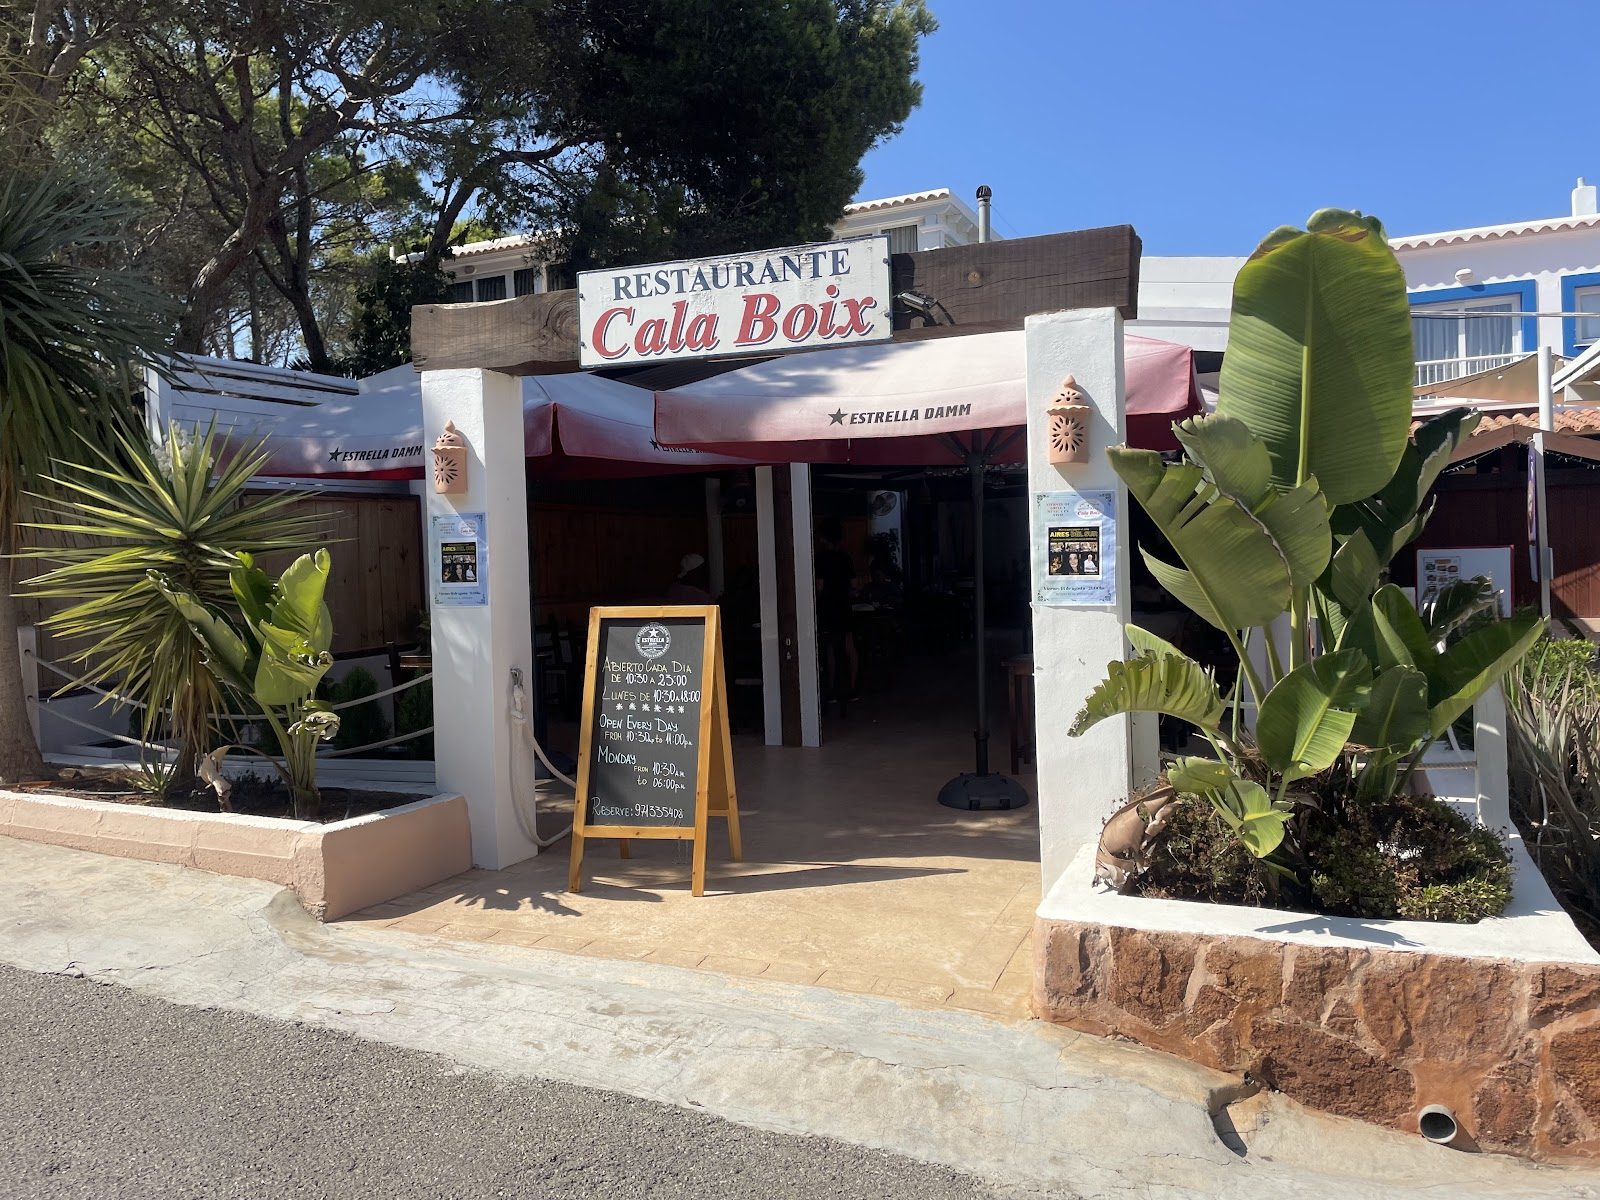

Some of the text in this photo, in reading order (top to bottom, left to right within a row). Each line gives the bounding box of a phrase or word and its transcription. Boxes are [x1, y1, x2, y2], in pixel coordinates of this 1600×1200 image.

[612, 247, 851, 301] RESTAURANTE
[591, 284, 877, 360] Cala Boix
[849, 403, 972, 425] ESTRELLA DAMM
[342, 445, 423, 462] ESTRELLA DAMM
[602, 656, 692, 674] ABIERTO CADA DIA
[611, 674, 622, 683] DE
[625, 673, 648, 684] 10:30
[657, 674, 687, 687] 23:00
[602, 686, 637, 701] LUNES
[639, 692, 651, 701] DE
[599, 713, 679, 732] OPEN EVERY DAY
[604, 731, 623, 741] FROM
[655, 735, 663, 743] to
[597, 745, 637, 765] MONDAY
[633, 765, 649, 773] FROM
[636, 775, 647, 786] to
